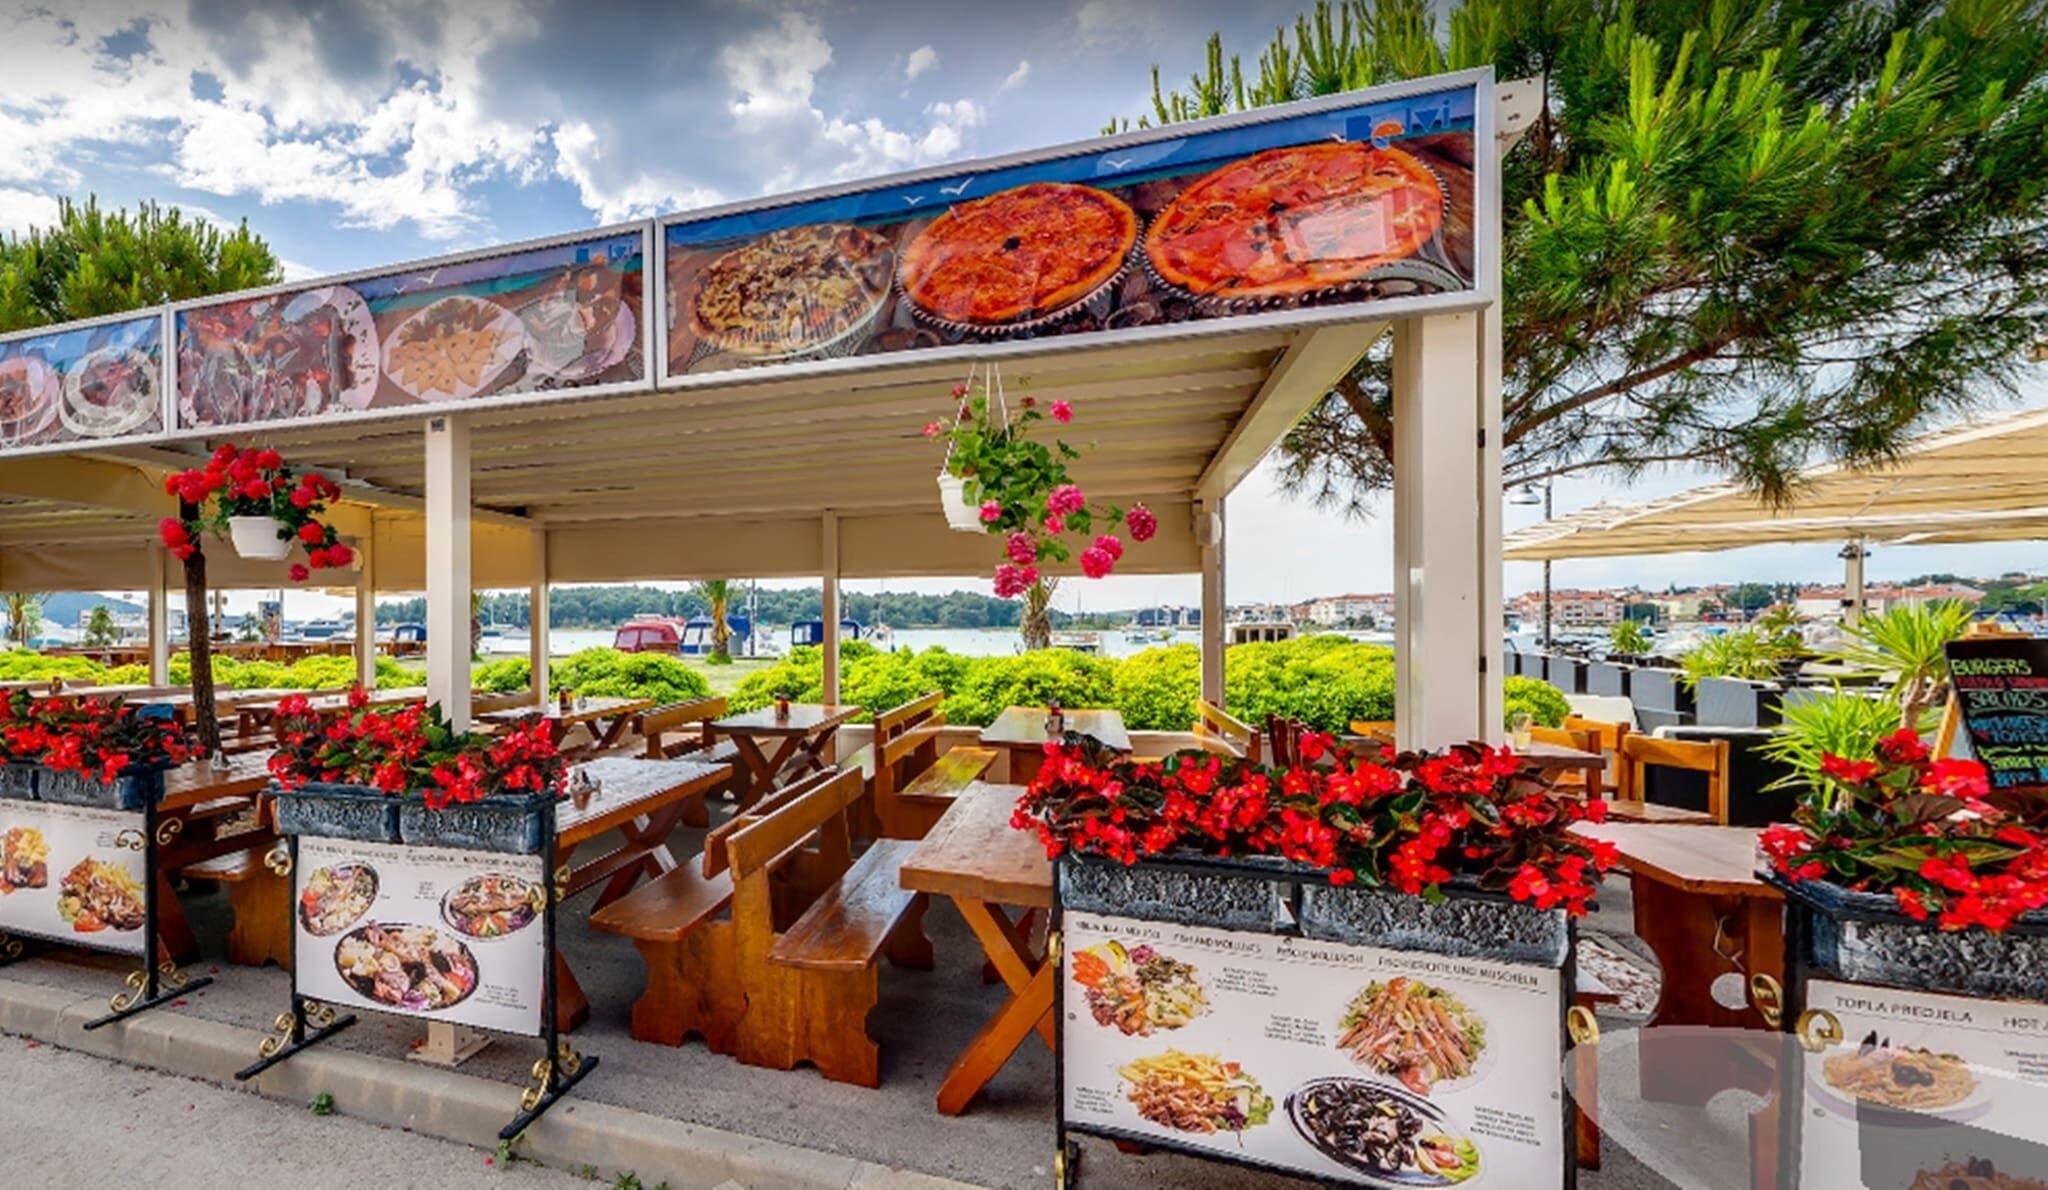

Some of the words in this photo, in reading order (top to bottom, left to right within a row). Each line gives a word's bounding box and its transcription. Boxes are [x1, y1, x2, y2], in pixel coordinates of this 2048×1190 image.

[1345, 98, 1451, 151] Belvi
[1951, 658, 2033, 675] BURGERS
[1836, 996, 1887, 1014] TOPLA
[2003, 1016, 2040, 1031] HOT
